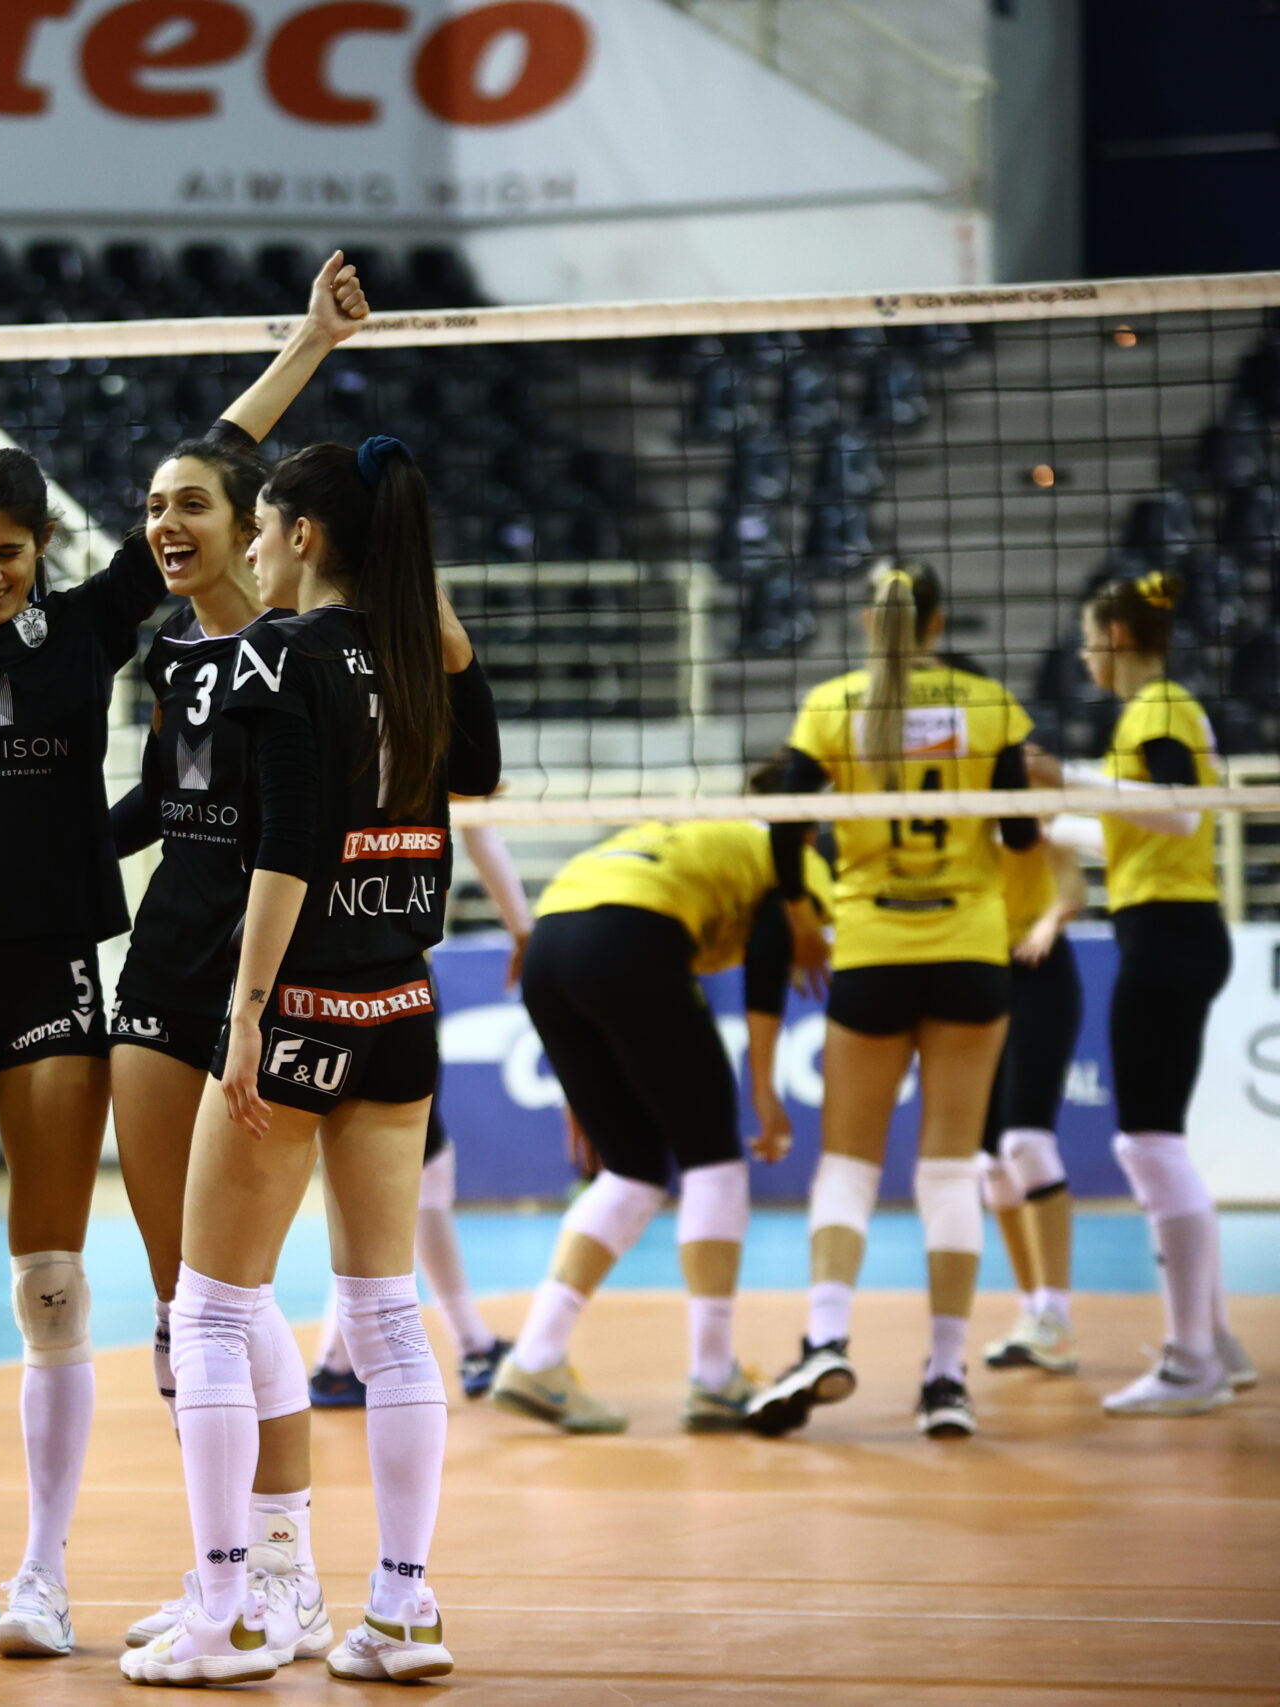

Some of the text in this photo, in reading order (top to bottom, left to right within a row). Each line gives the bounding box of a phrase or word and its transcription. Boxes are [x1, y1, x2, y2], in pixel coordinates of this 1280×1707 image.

[1027, 289, 1057, 304] Cup
[412, 317, 441, 330] Cup
[187, 662, 218, 726] 3
[70, 959, 95, 1004] 5
[320, 987, 431, 1021] MORRIS
[12, 1018, 71, 1050] avance
